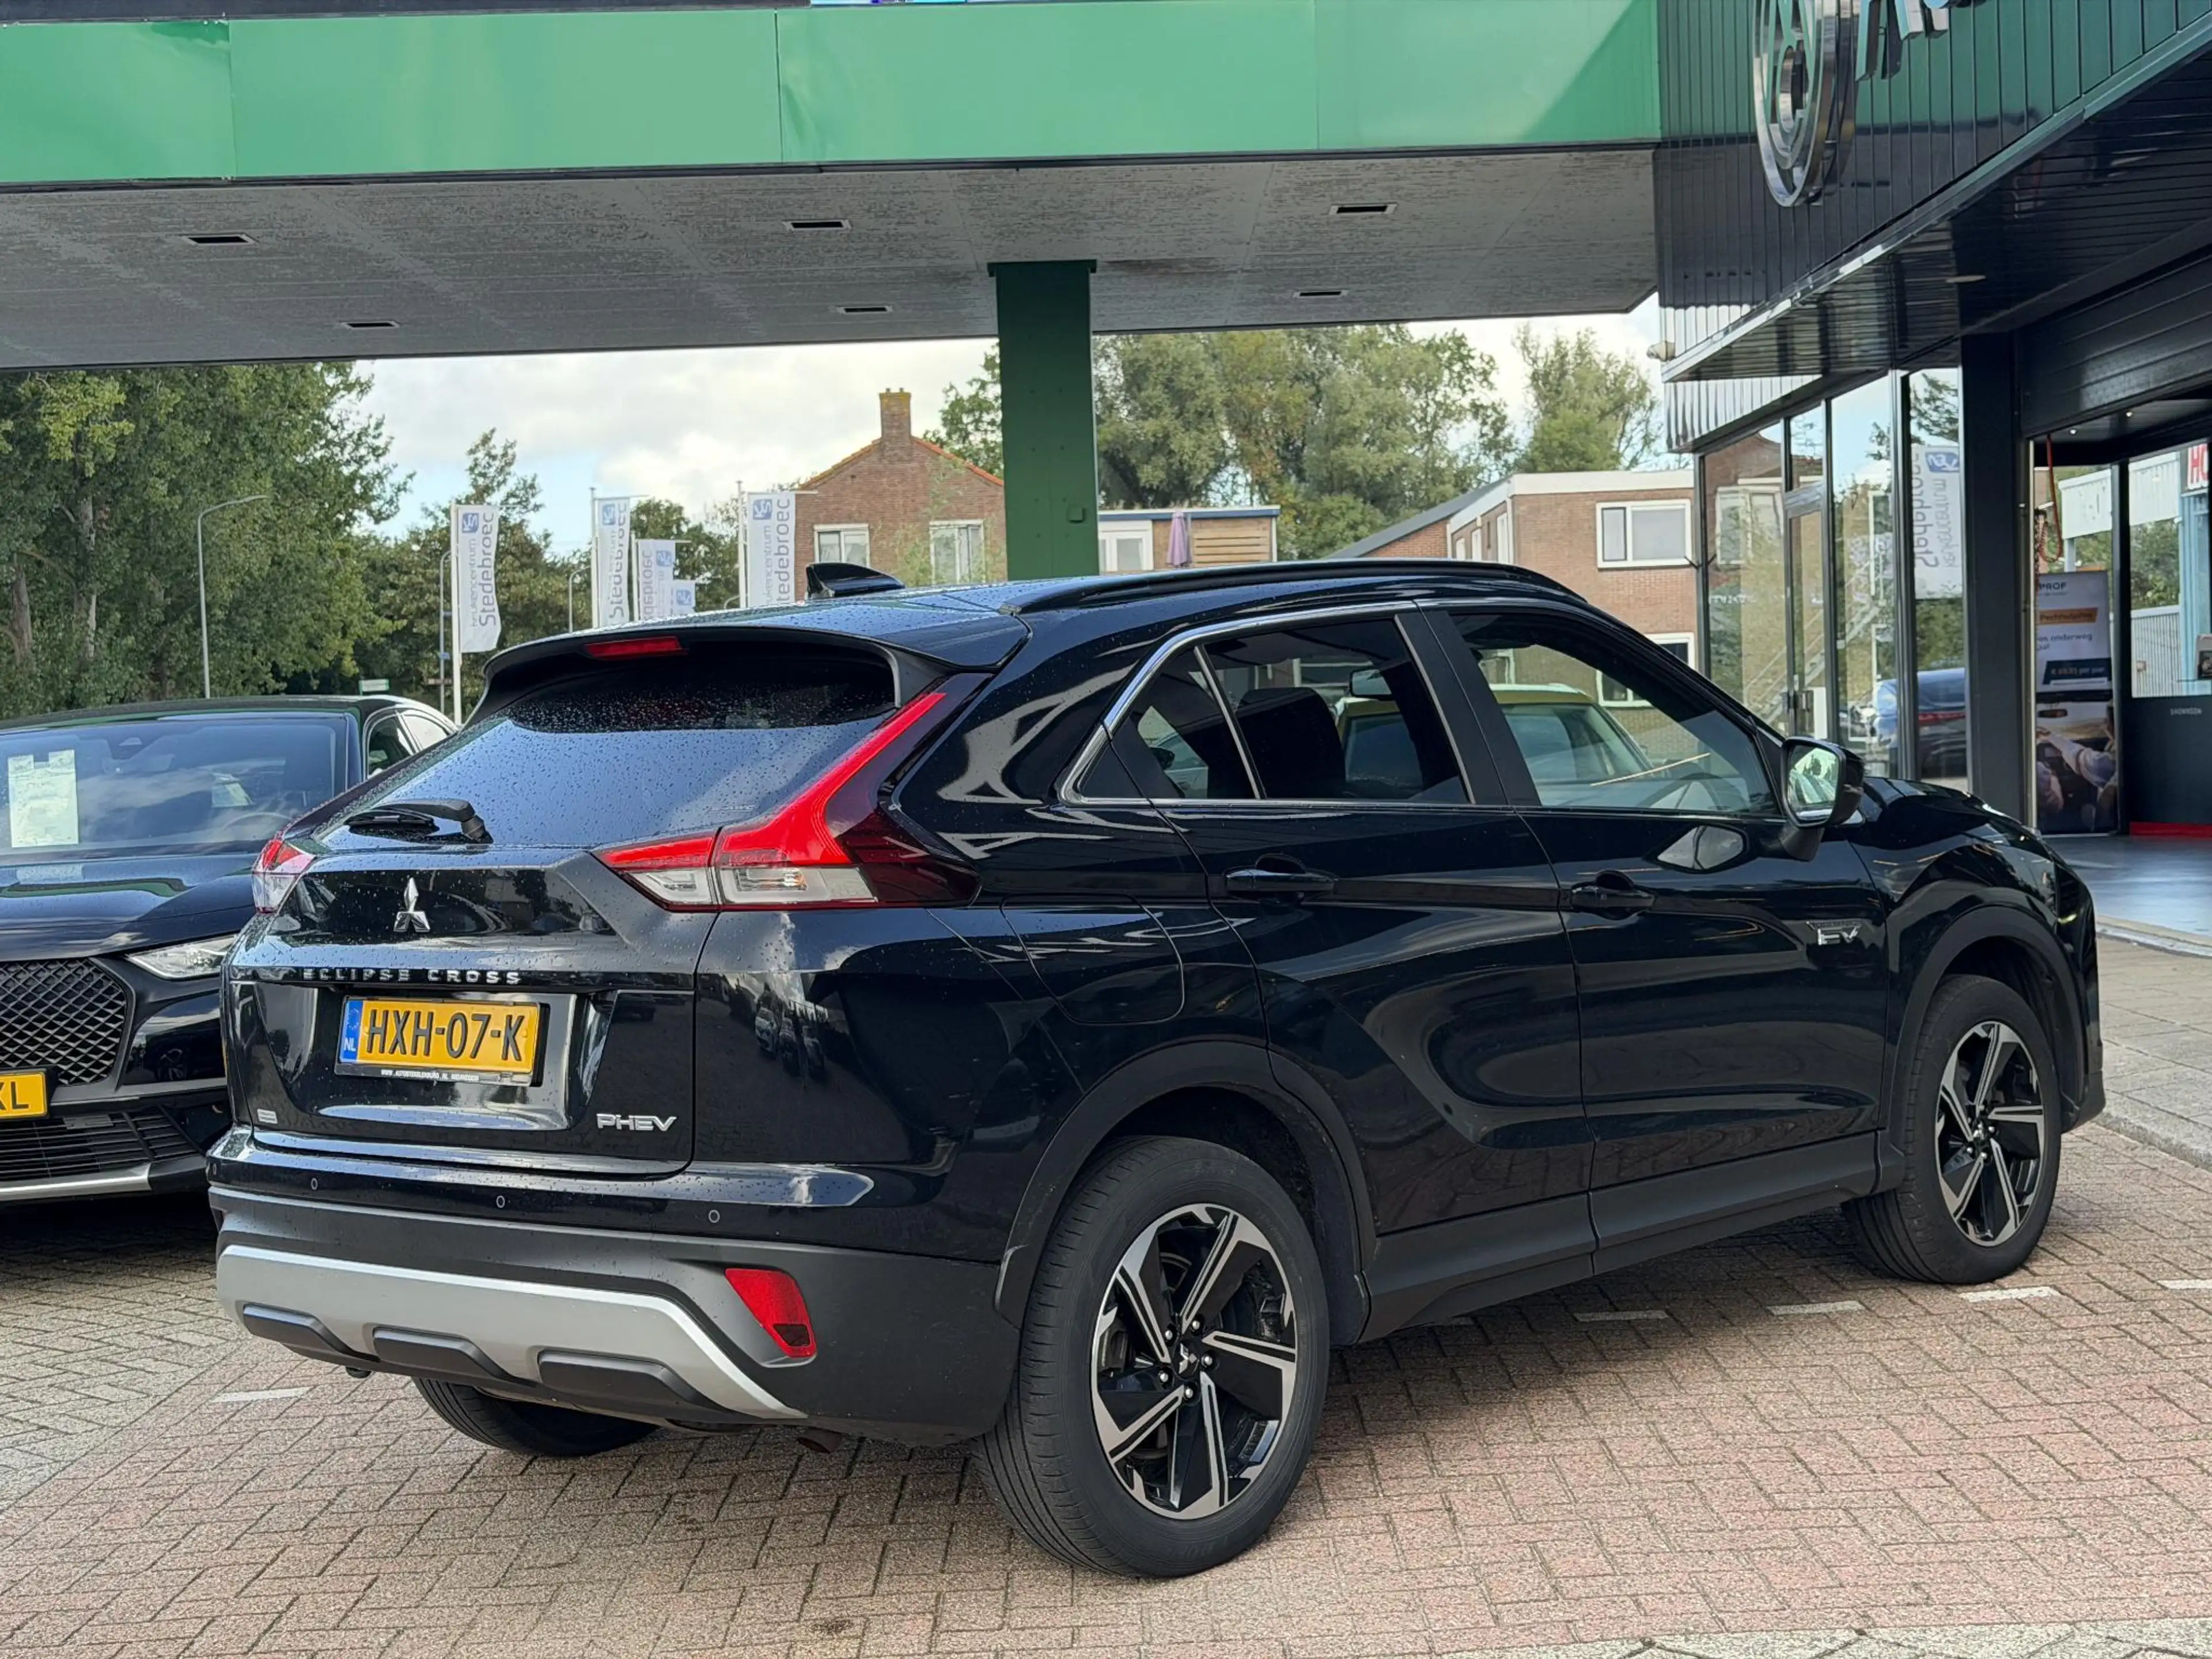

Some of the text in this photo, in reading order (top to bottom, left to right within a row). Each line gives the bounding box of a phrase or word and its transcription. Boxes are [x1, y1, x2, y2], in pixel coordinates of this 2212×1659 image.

[477, 512, 496, 627] Stedebroec
[762, 526, 773, 604] ukencentrum
[773, 498, 790, 603] tedebroec
[303, 968, 522, 985] ECLIPSE CROSS
[344, 1037, 357, 1052] NL
[366, 1009, 524, 1061] HXH-07-K
[596, 1113, 677, 1132] PHEV
